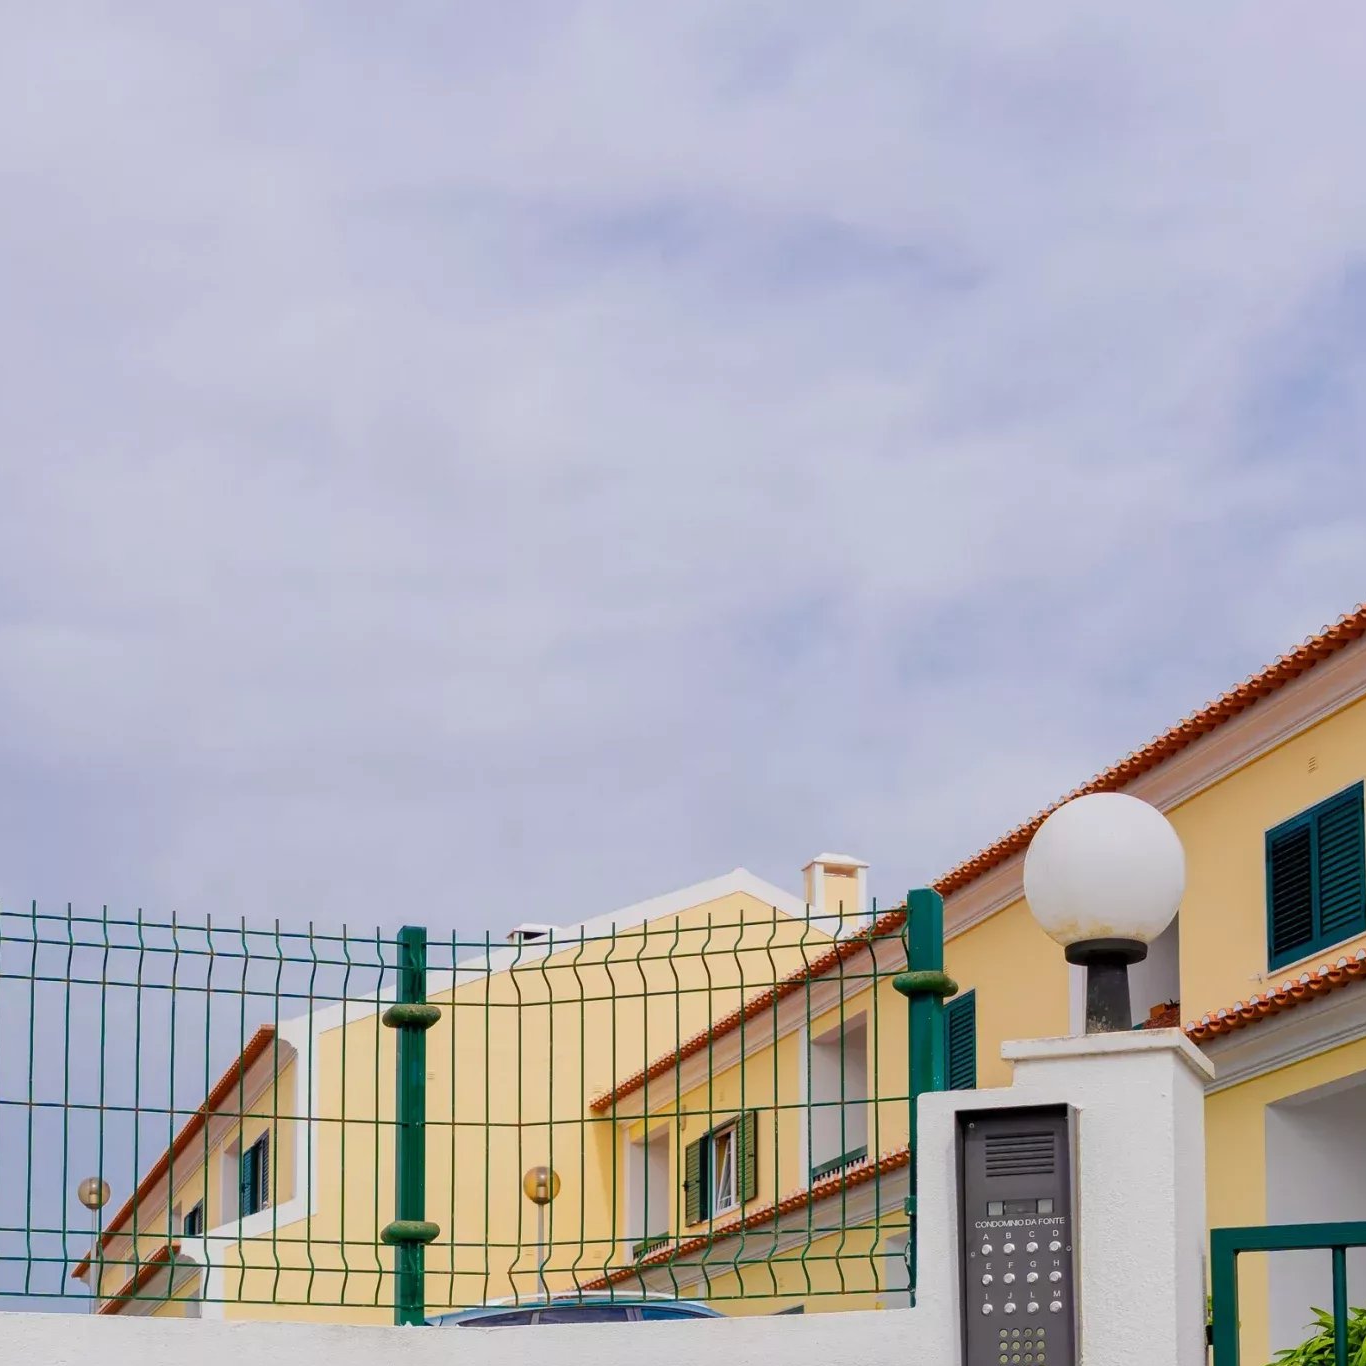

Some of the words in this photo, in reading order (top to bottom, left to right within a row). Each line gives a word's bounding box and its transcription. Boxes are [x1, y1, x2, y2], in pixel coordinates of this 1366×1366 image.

[1025, 1218, 1037, 1226] DA
[1038, 1217, 1065, 1225] FONTE
[982, 1233, 989, 1241] A
[1028, 1230, 1035, 1238] C
[1052, 1229, 1059, 1237] D
[985, 1262, 992, 1270] E
[1008, 1261, 1014, 1269] F
[1029, 1260, 1037, 1268] G
[1053, 1259, 1060, 1267] H
